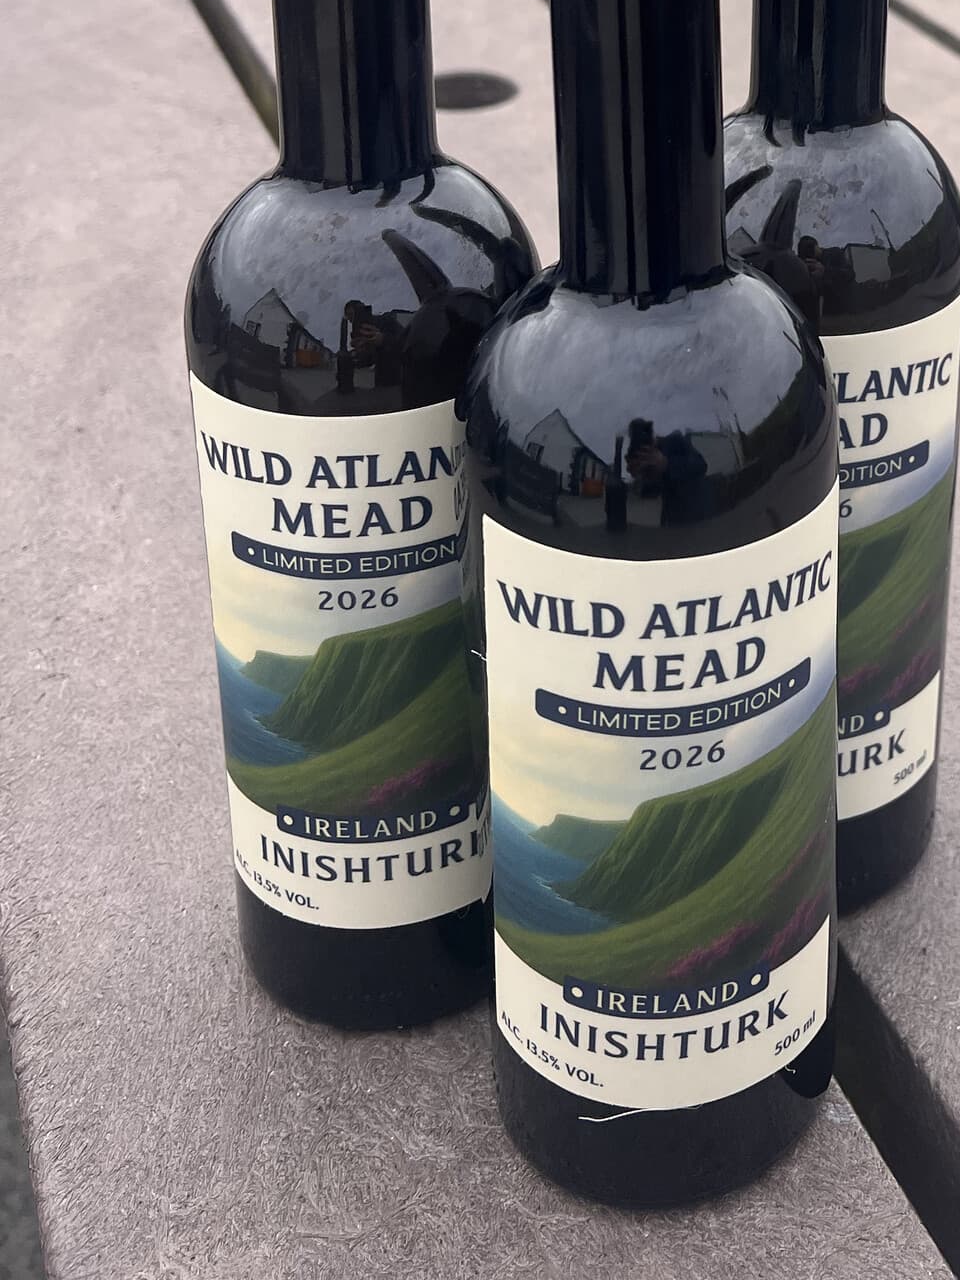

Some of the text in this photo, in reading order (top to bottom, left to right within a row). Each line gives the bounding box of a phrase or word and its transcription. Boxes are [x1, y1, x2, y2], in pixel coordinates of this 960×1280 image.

[833, 353, 953, 403] LANTIC
[839, 413, 889, 449] AD
[200, 430, 292, 486] WILD
[306, 446, 455, 489] ATLAN
[839, 456, 902, 483] DITION
[272, 495, 433, 538] MEAD
[262, 540, 456, 574] LIMITED EDITION
[318, 586, 399, 611] 2026
[497, 550, 833, 639] WILD ATLANTIC
[592, 636, 766, 692] MEAD
[577, 683, 782, 731] LIMITED EDITION
[639, 739, 726, 771] 2026
[304, 810, 437, 839] IRELAND
[253, 871, 282, 897] 13.5%
[285, 889, 320, 910] VOL.
[596, 980, 739, 1015] IRELAND
[538, 988, 790, 1061] INISHTURK
[773, 1010, 817, 1056] 500 ml
[501, 1010, 605, 1087] ALC. 13.5% VOL.
